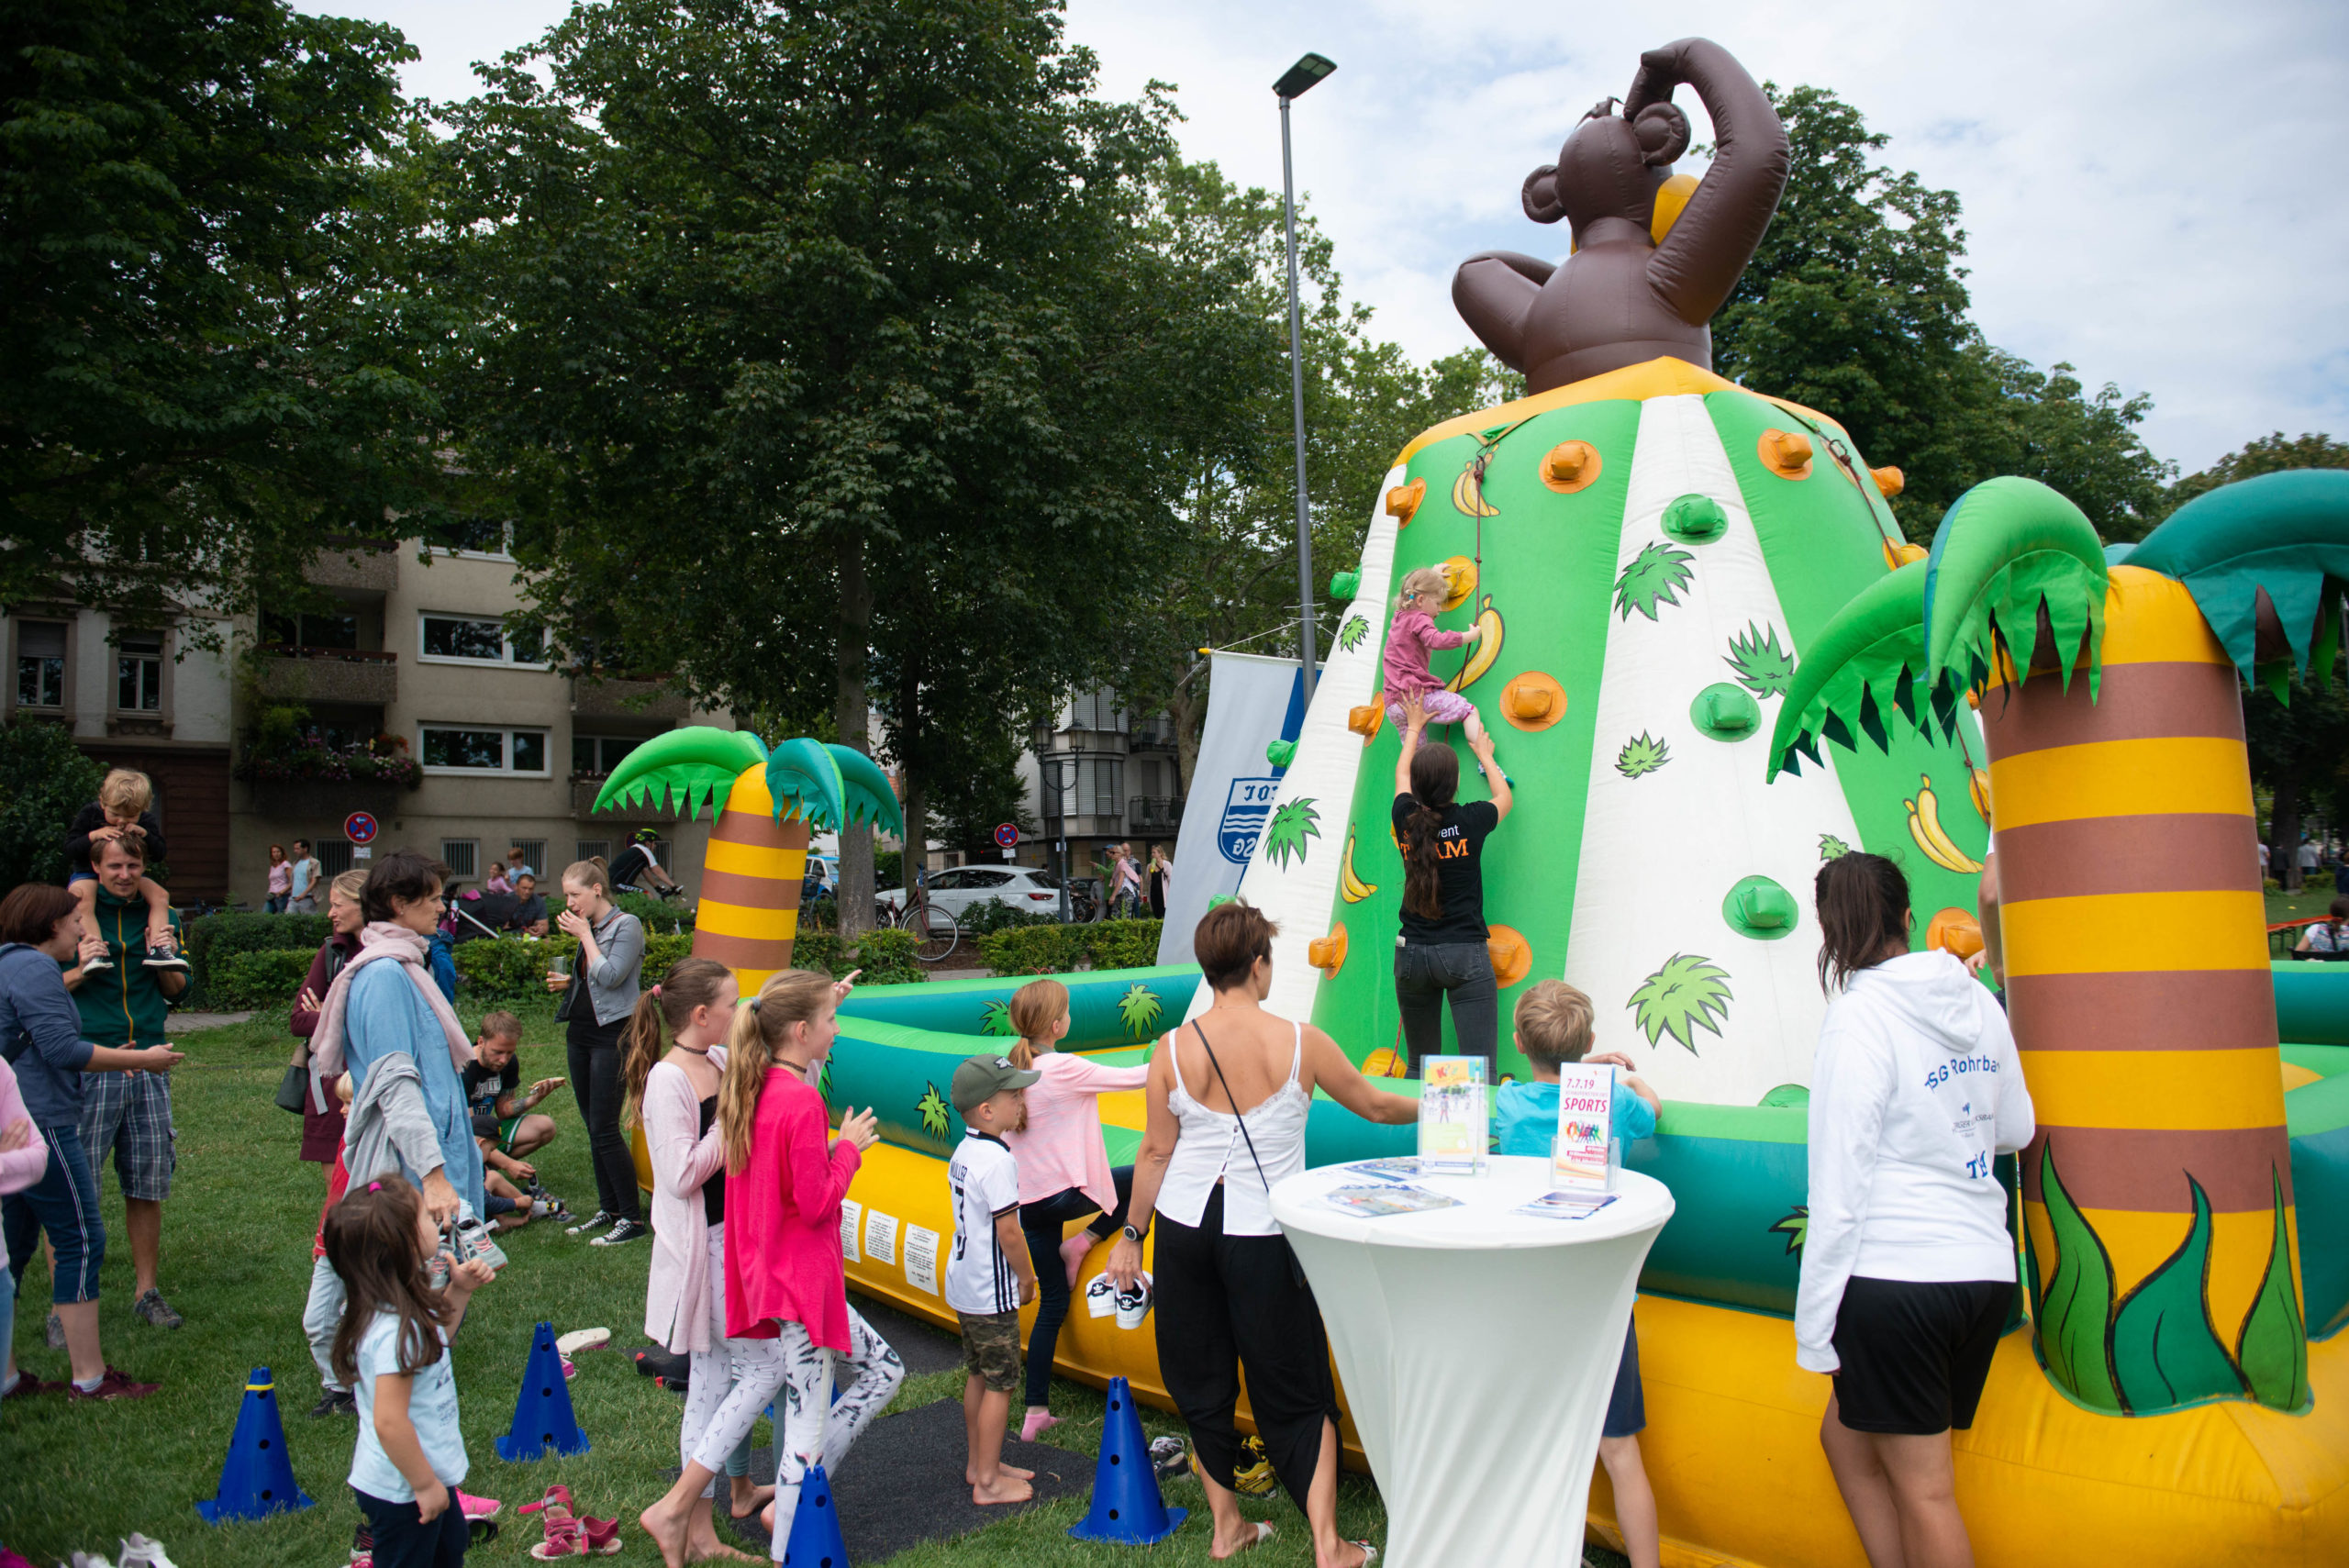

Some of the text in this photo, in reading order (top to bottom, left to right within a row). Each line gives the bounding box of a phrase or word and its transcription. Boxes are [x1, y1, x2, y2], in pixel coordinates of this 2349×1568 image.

[1924, 1053, 2000, 1094] TSG Rohrba
[1566, 1078, 1595, 1090] 7.7.19
[1564, 1097, 1608, 1113] SPORTS
[950, 1159, 968, 1183] MÜLLER
